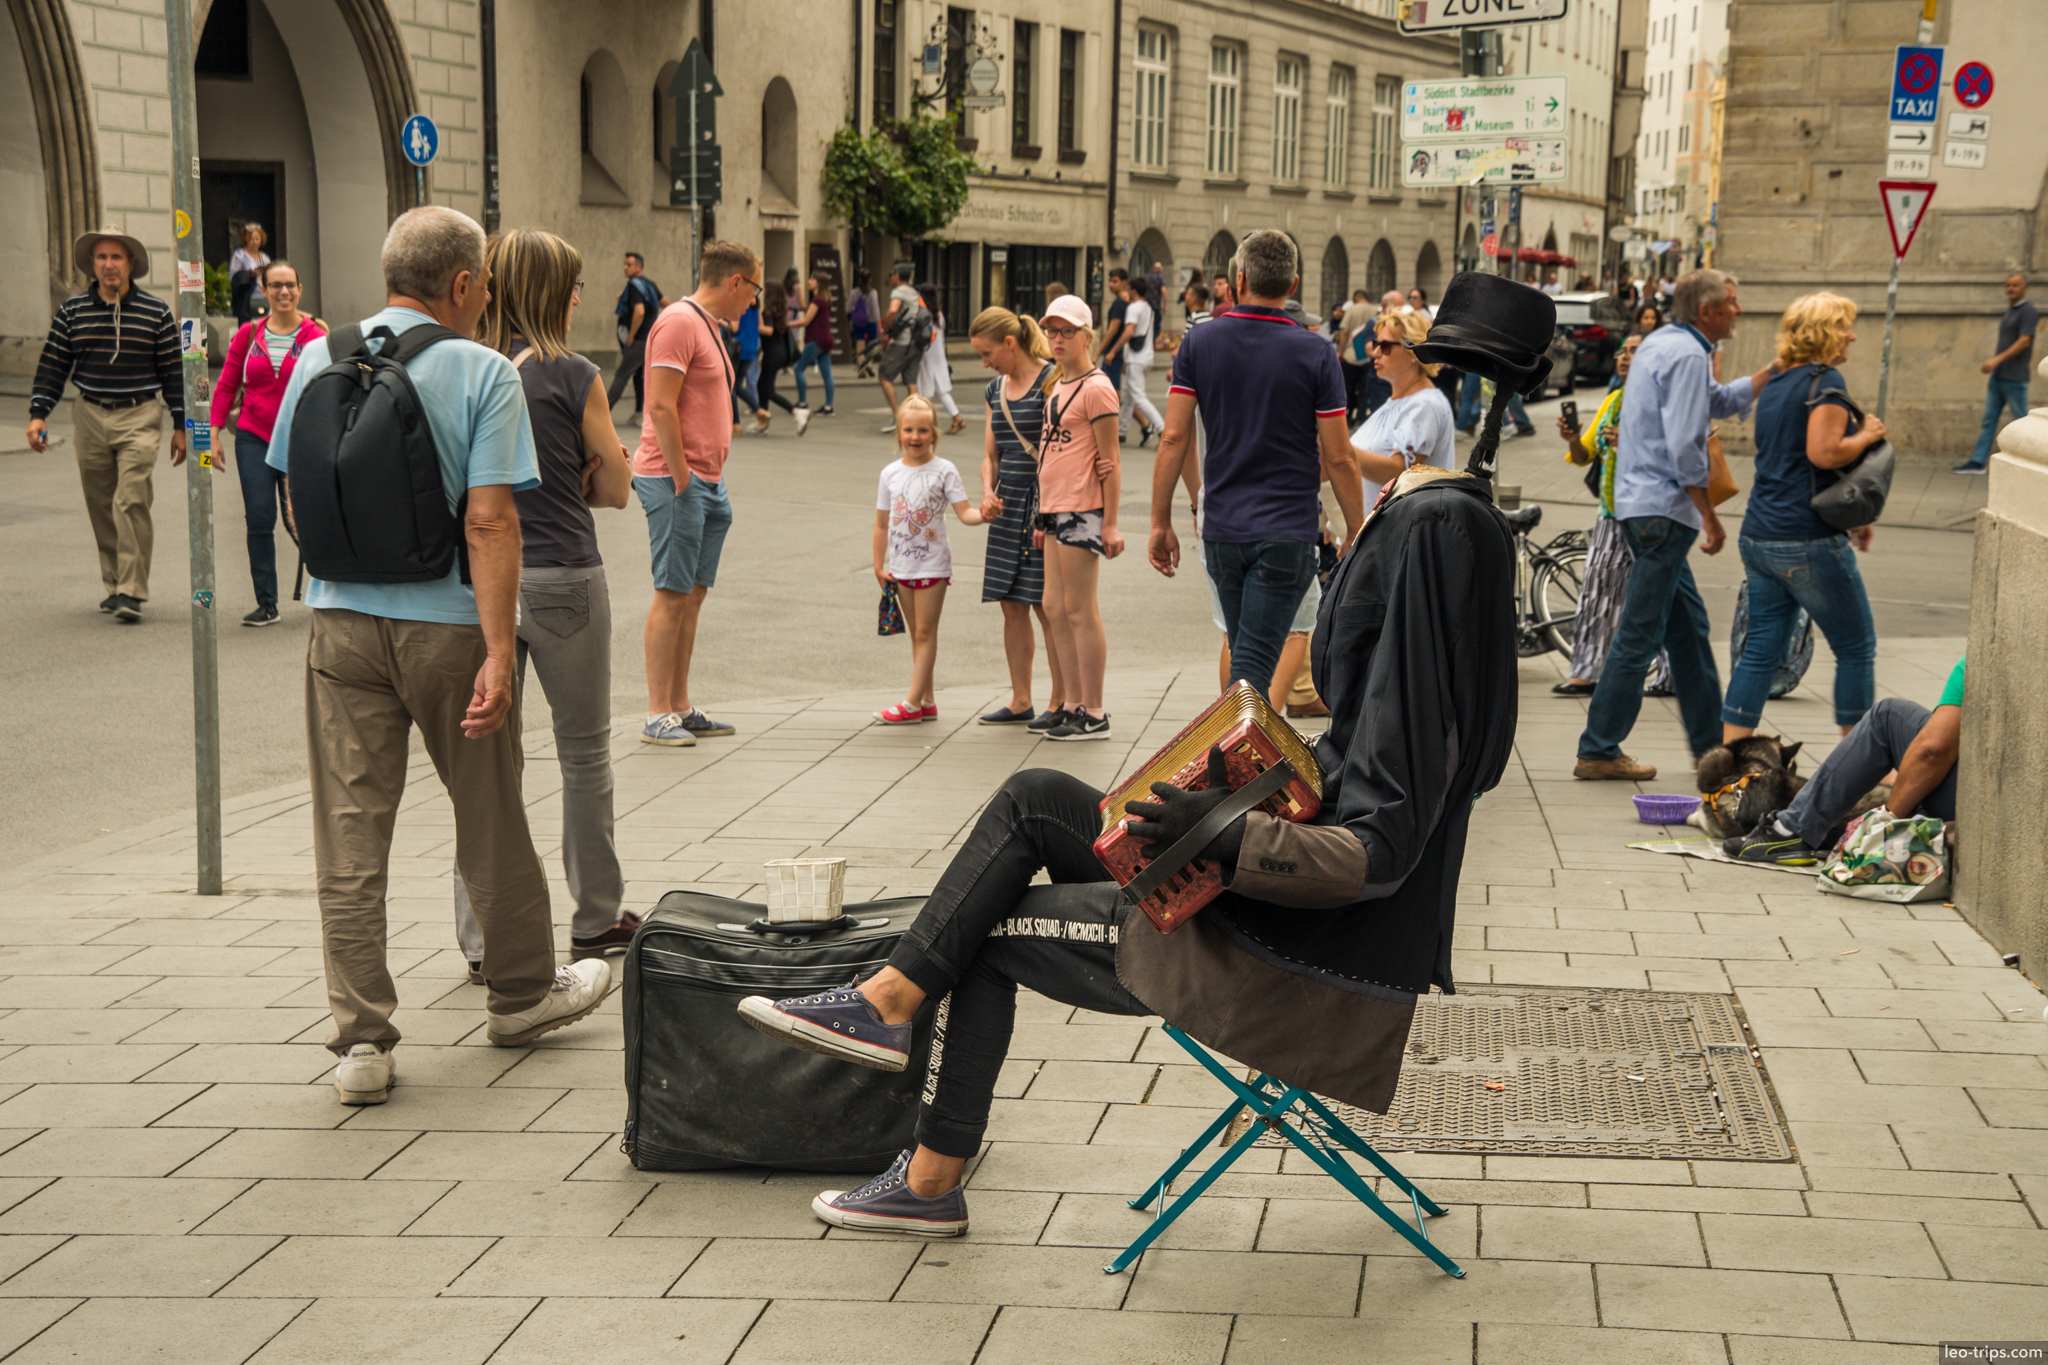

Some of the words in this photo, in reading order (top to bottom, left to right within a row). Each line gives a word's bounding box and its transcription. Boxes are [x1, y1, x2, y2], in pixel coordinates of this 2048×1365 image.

[1424, 86, 1458, 100] Südöstl.
[1460, 84, 1515, 98] Stadtbezirke
[1895, 98, 1934, 117] TAXI
[1423, 121, 1470, 135] Deutes
[1474, 120, 1514, 132] Museum
[1007, 917, 1034, 937] BLACK
[1034, 917, 1060, 938] SQUAD
[1068, 920, 1105, 943] MCMXCII
[352, 1050, 376, 1058] Reebok
[929, 1039, 944, 1073] SQUAD
[922, 1070, 939, 1105] BLACK
